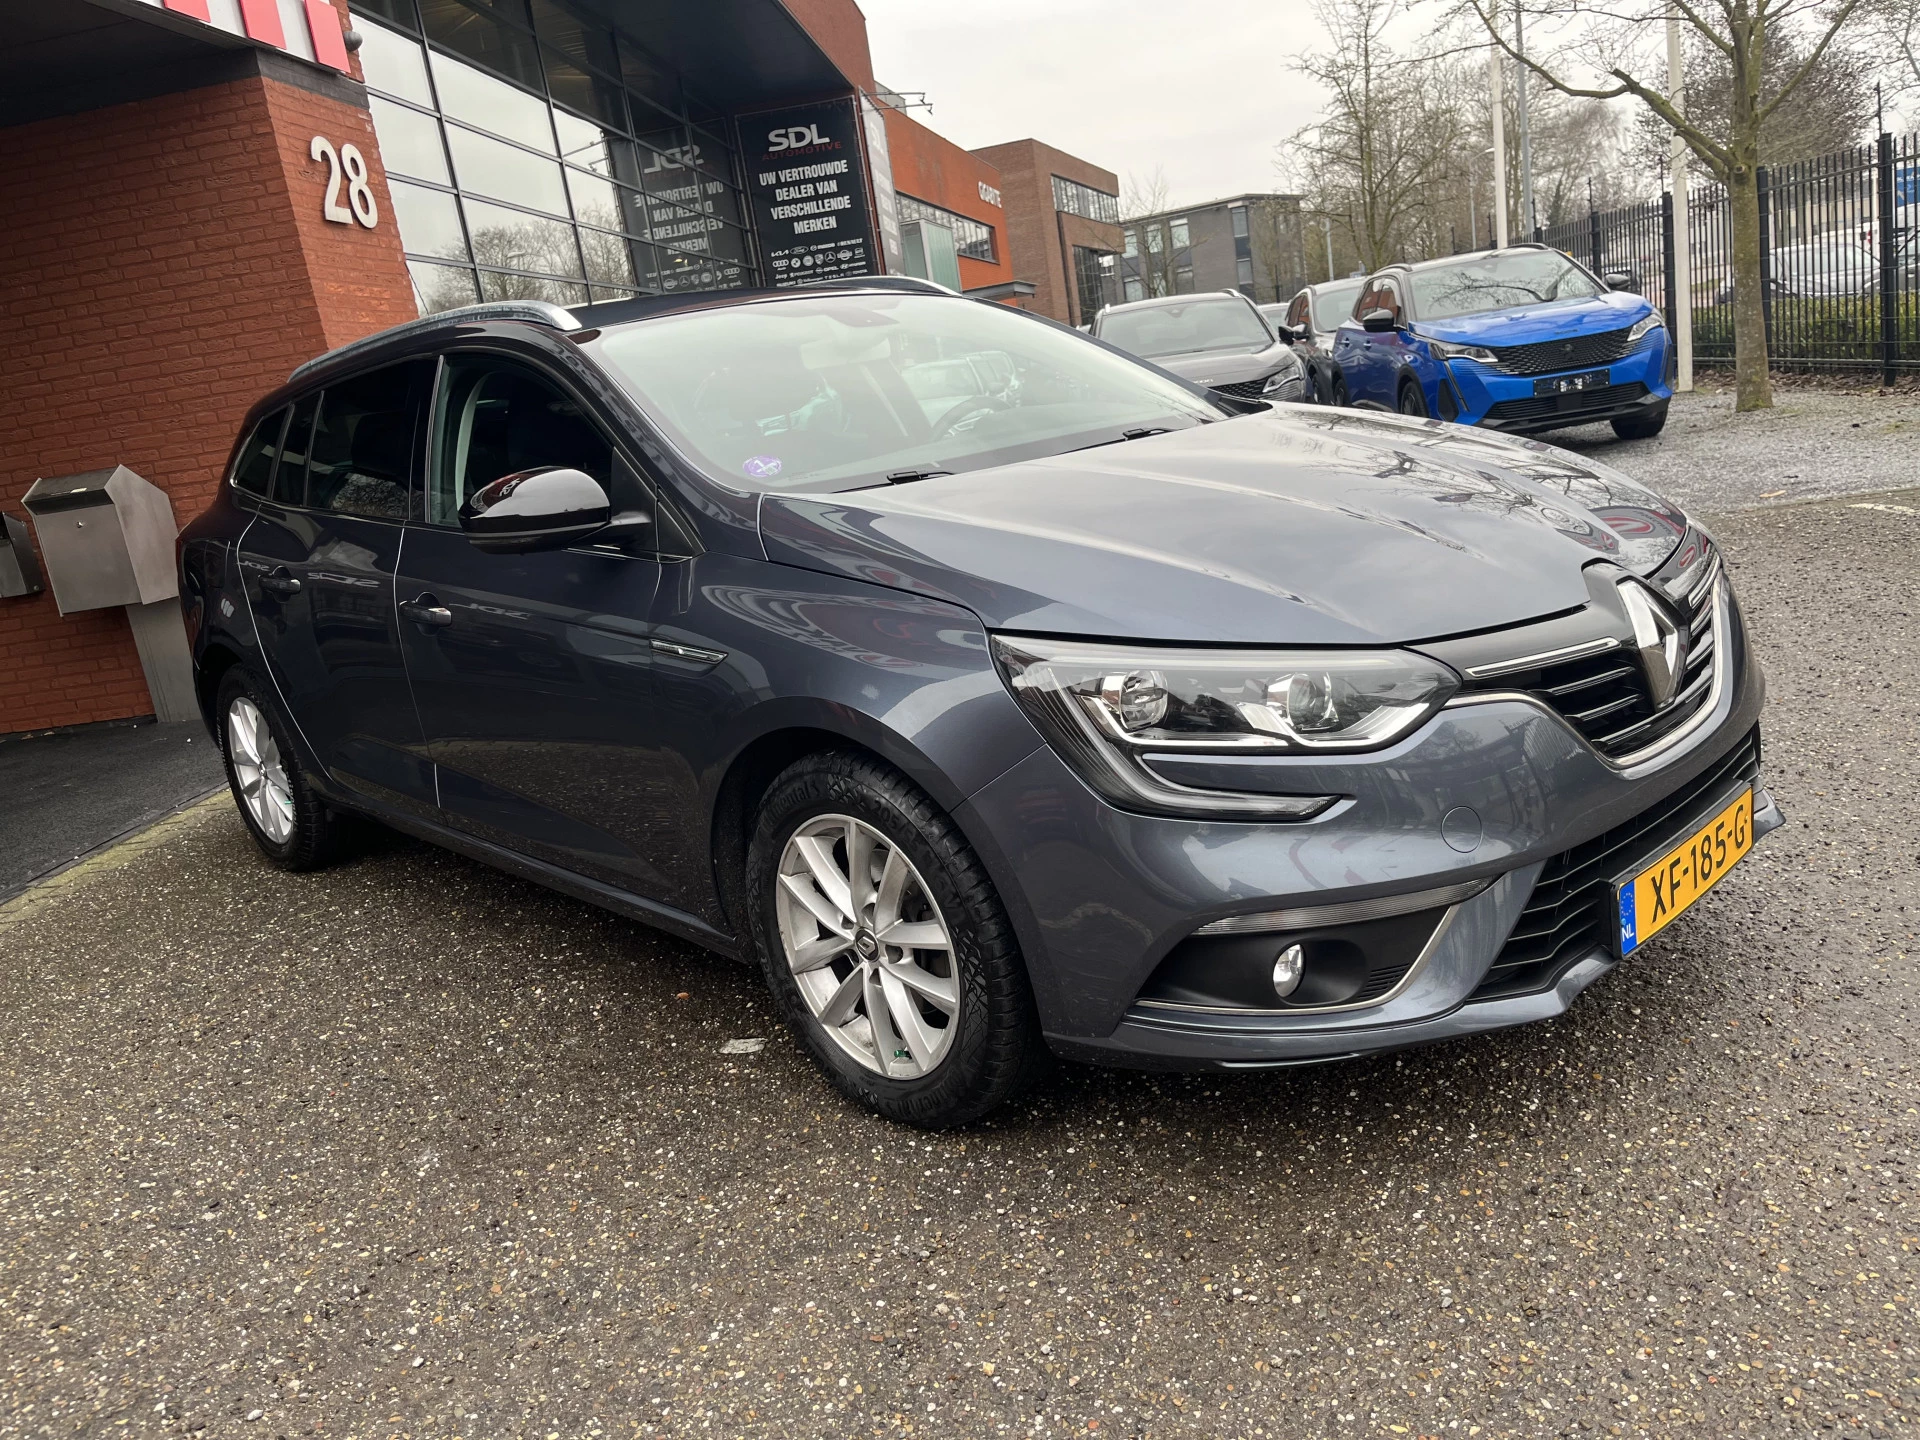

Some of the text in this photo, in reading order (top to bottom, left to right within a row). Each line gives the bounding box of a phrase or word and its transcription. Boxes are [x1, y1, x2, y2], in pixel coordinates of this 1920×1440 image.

[768, 124, 830, 152] SDL
[762, 141, 842, 160] AUTOMOTIVE
[311, 136, 378, 229] 28
[759, 160, 848, 186] UW VERTROUWDE
[775, 180, 838, 201] DEALER VAN
[771, 196, 851, 220] VERSCHILLENDE
[794, 216, 837, 234] MERKEN
[1651, 804, 1745, 924] XF-185-G
[1621, 924, 1635, 942] NL
